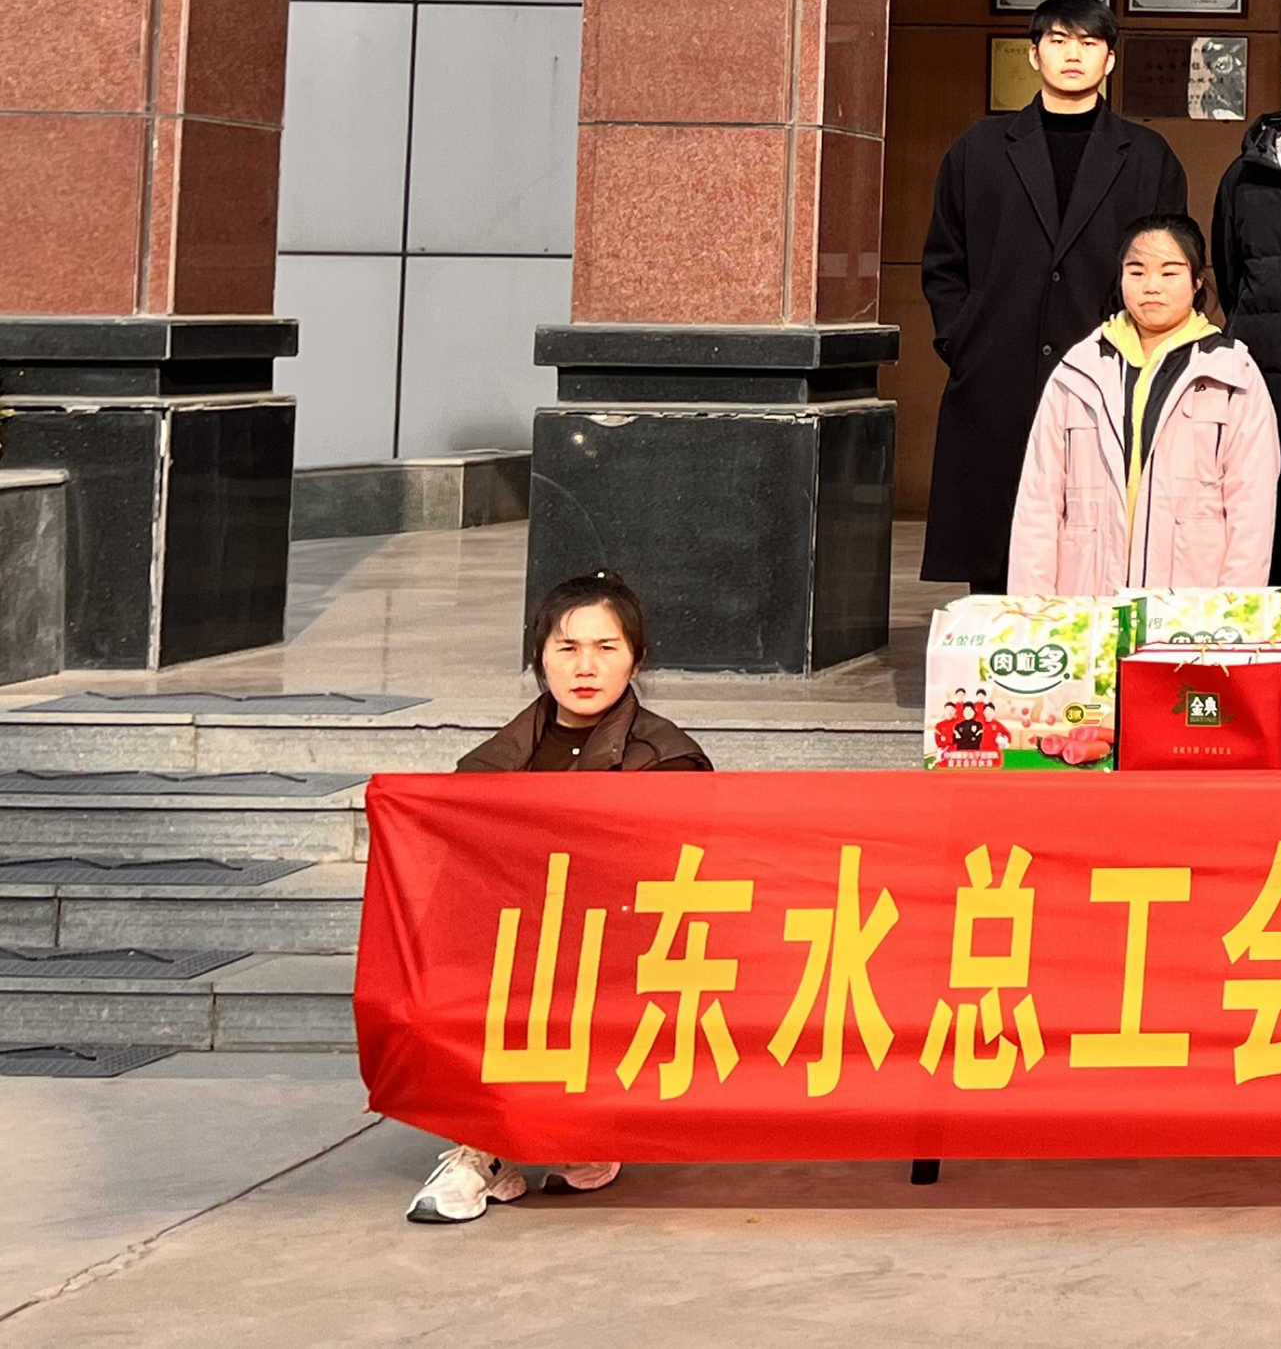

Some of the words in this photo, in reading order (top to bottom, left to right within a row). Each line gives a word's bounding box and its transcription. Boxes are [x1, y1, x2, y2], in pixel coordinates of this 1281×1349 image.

[993, 645, 1067, 678] 肉粒多
[1189, 696, 1218, 717] 金典
